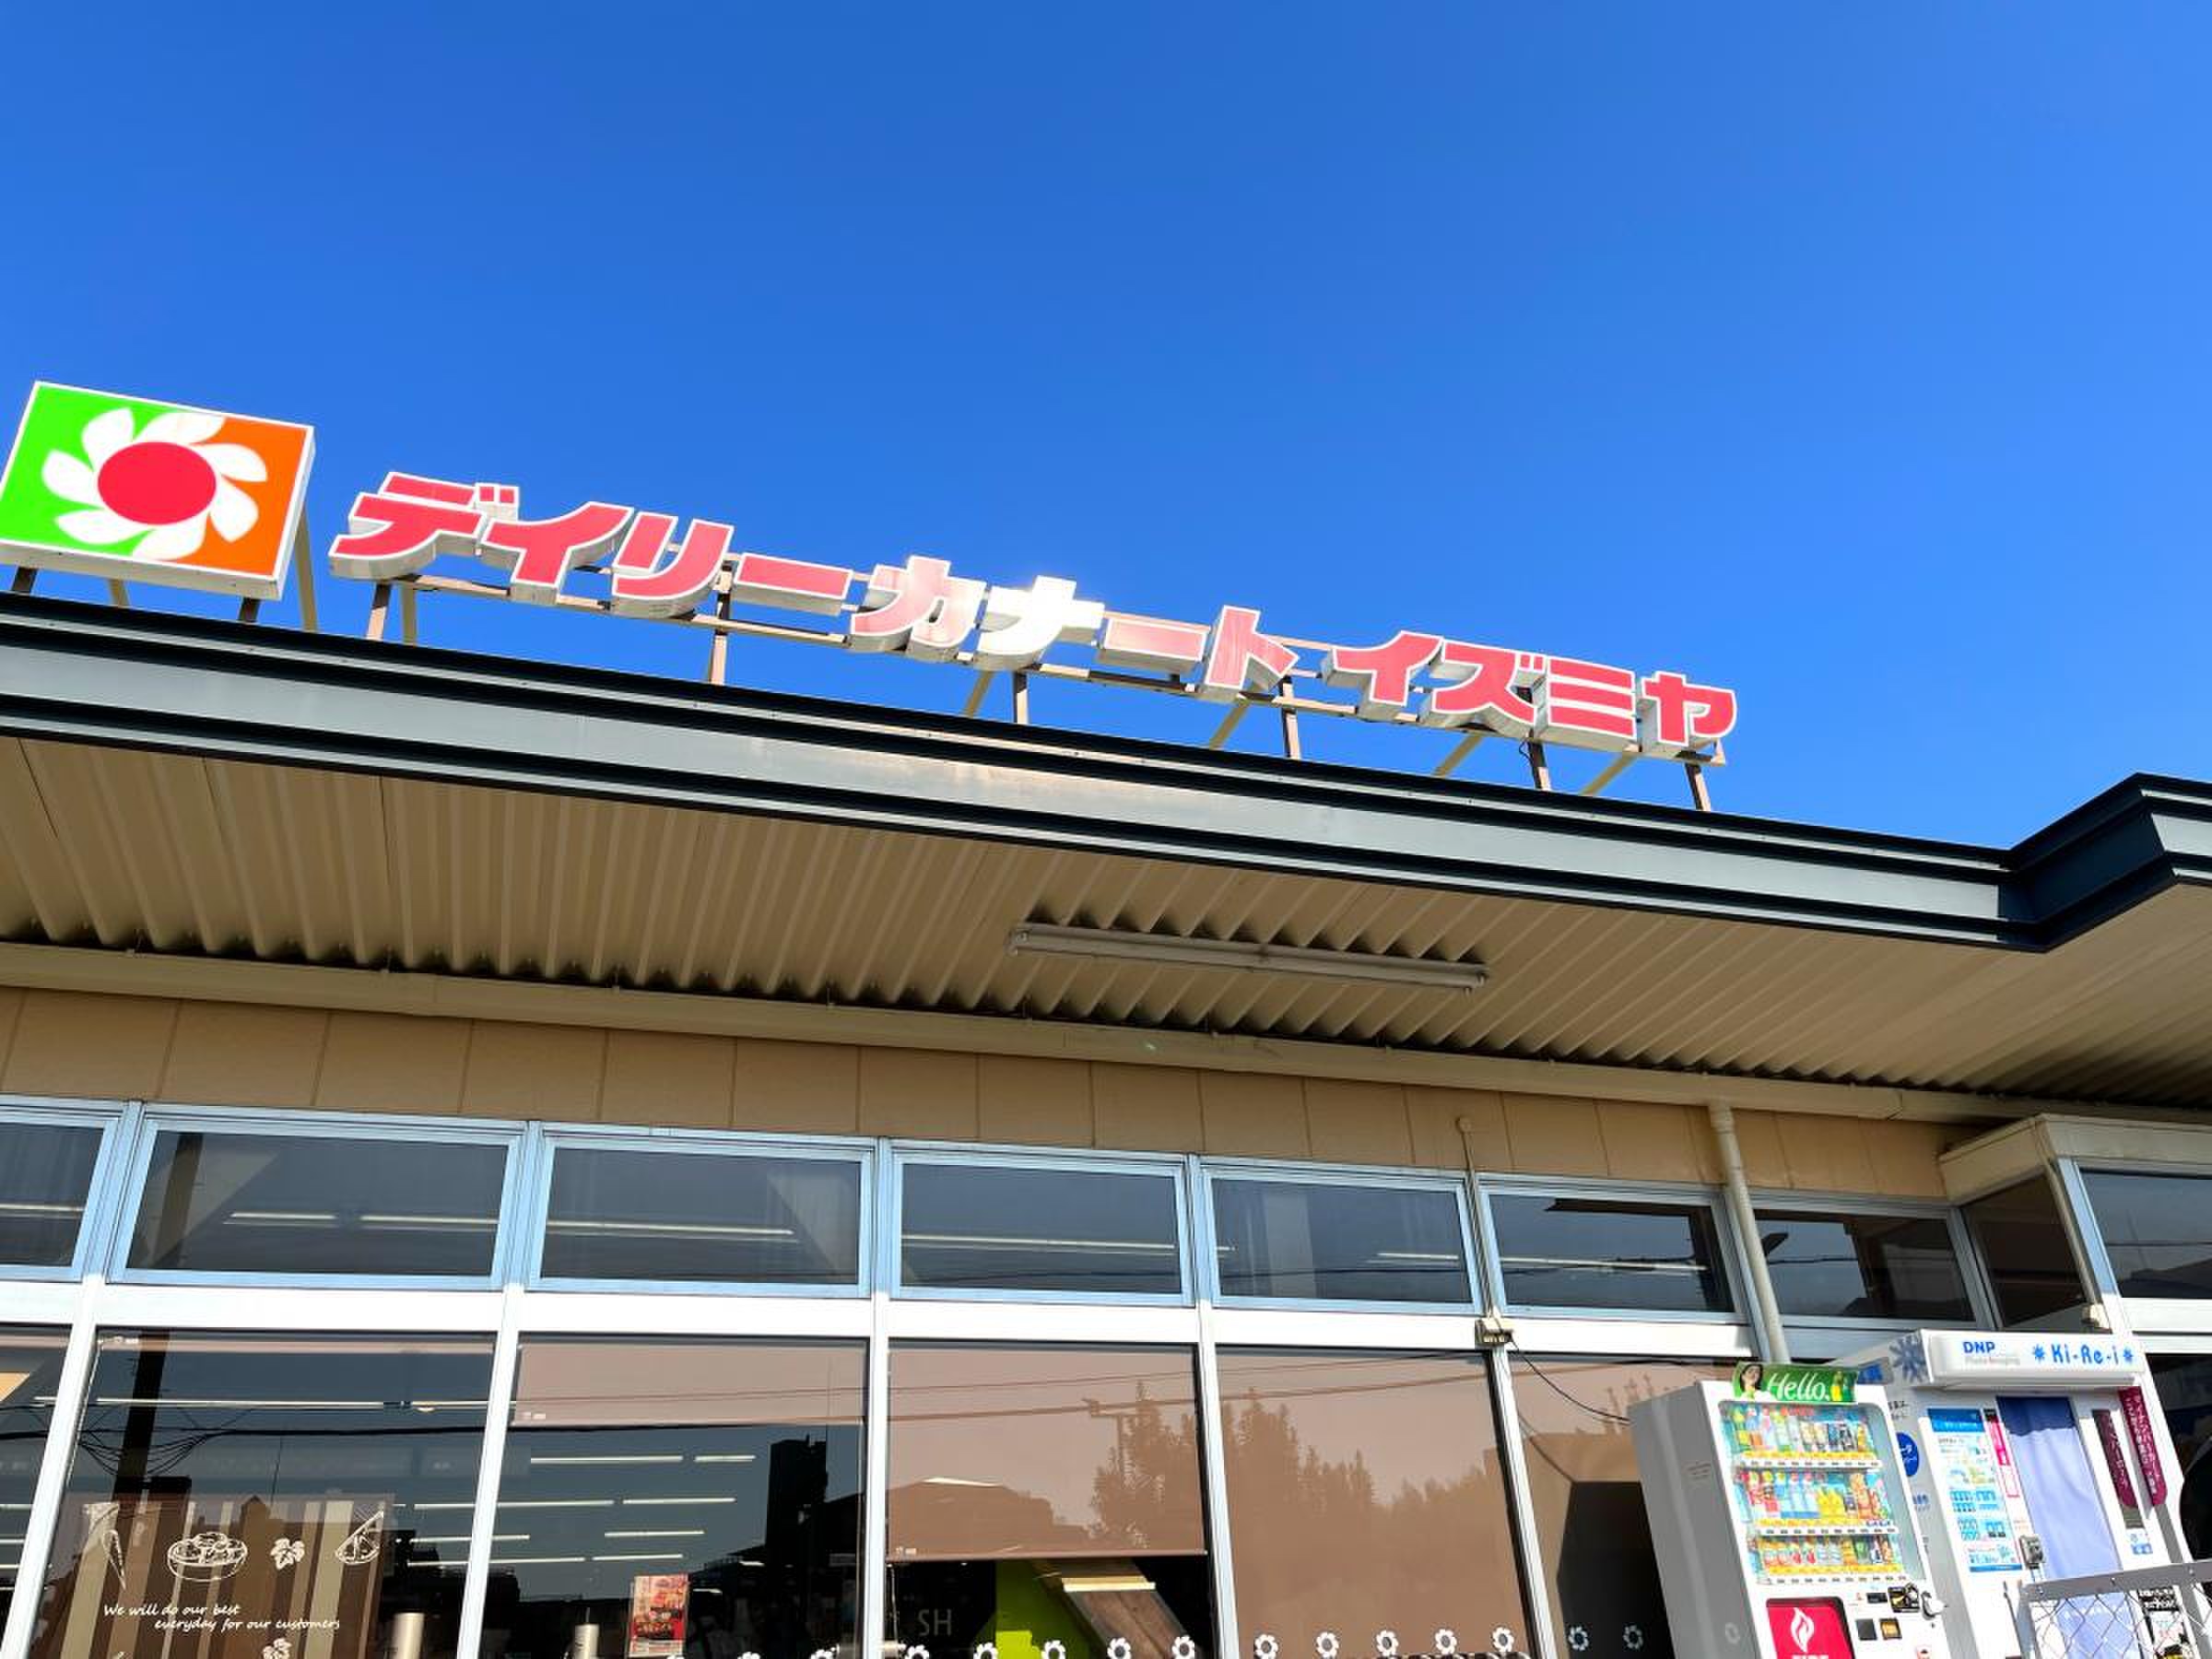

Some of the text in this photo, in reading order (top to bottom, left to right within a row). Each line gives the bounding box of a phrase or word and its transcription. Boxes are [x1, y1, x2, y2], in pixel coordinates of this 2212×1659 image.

[1962, 1341, 1995, 1354] DNP
[1767, 1371, 1831, 1402] Hello.
[103, 1603, 241, 1617] We will do our best
[154, 1617, 340, 1633] everyday for our customers
